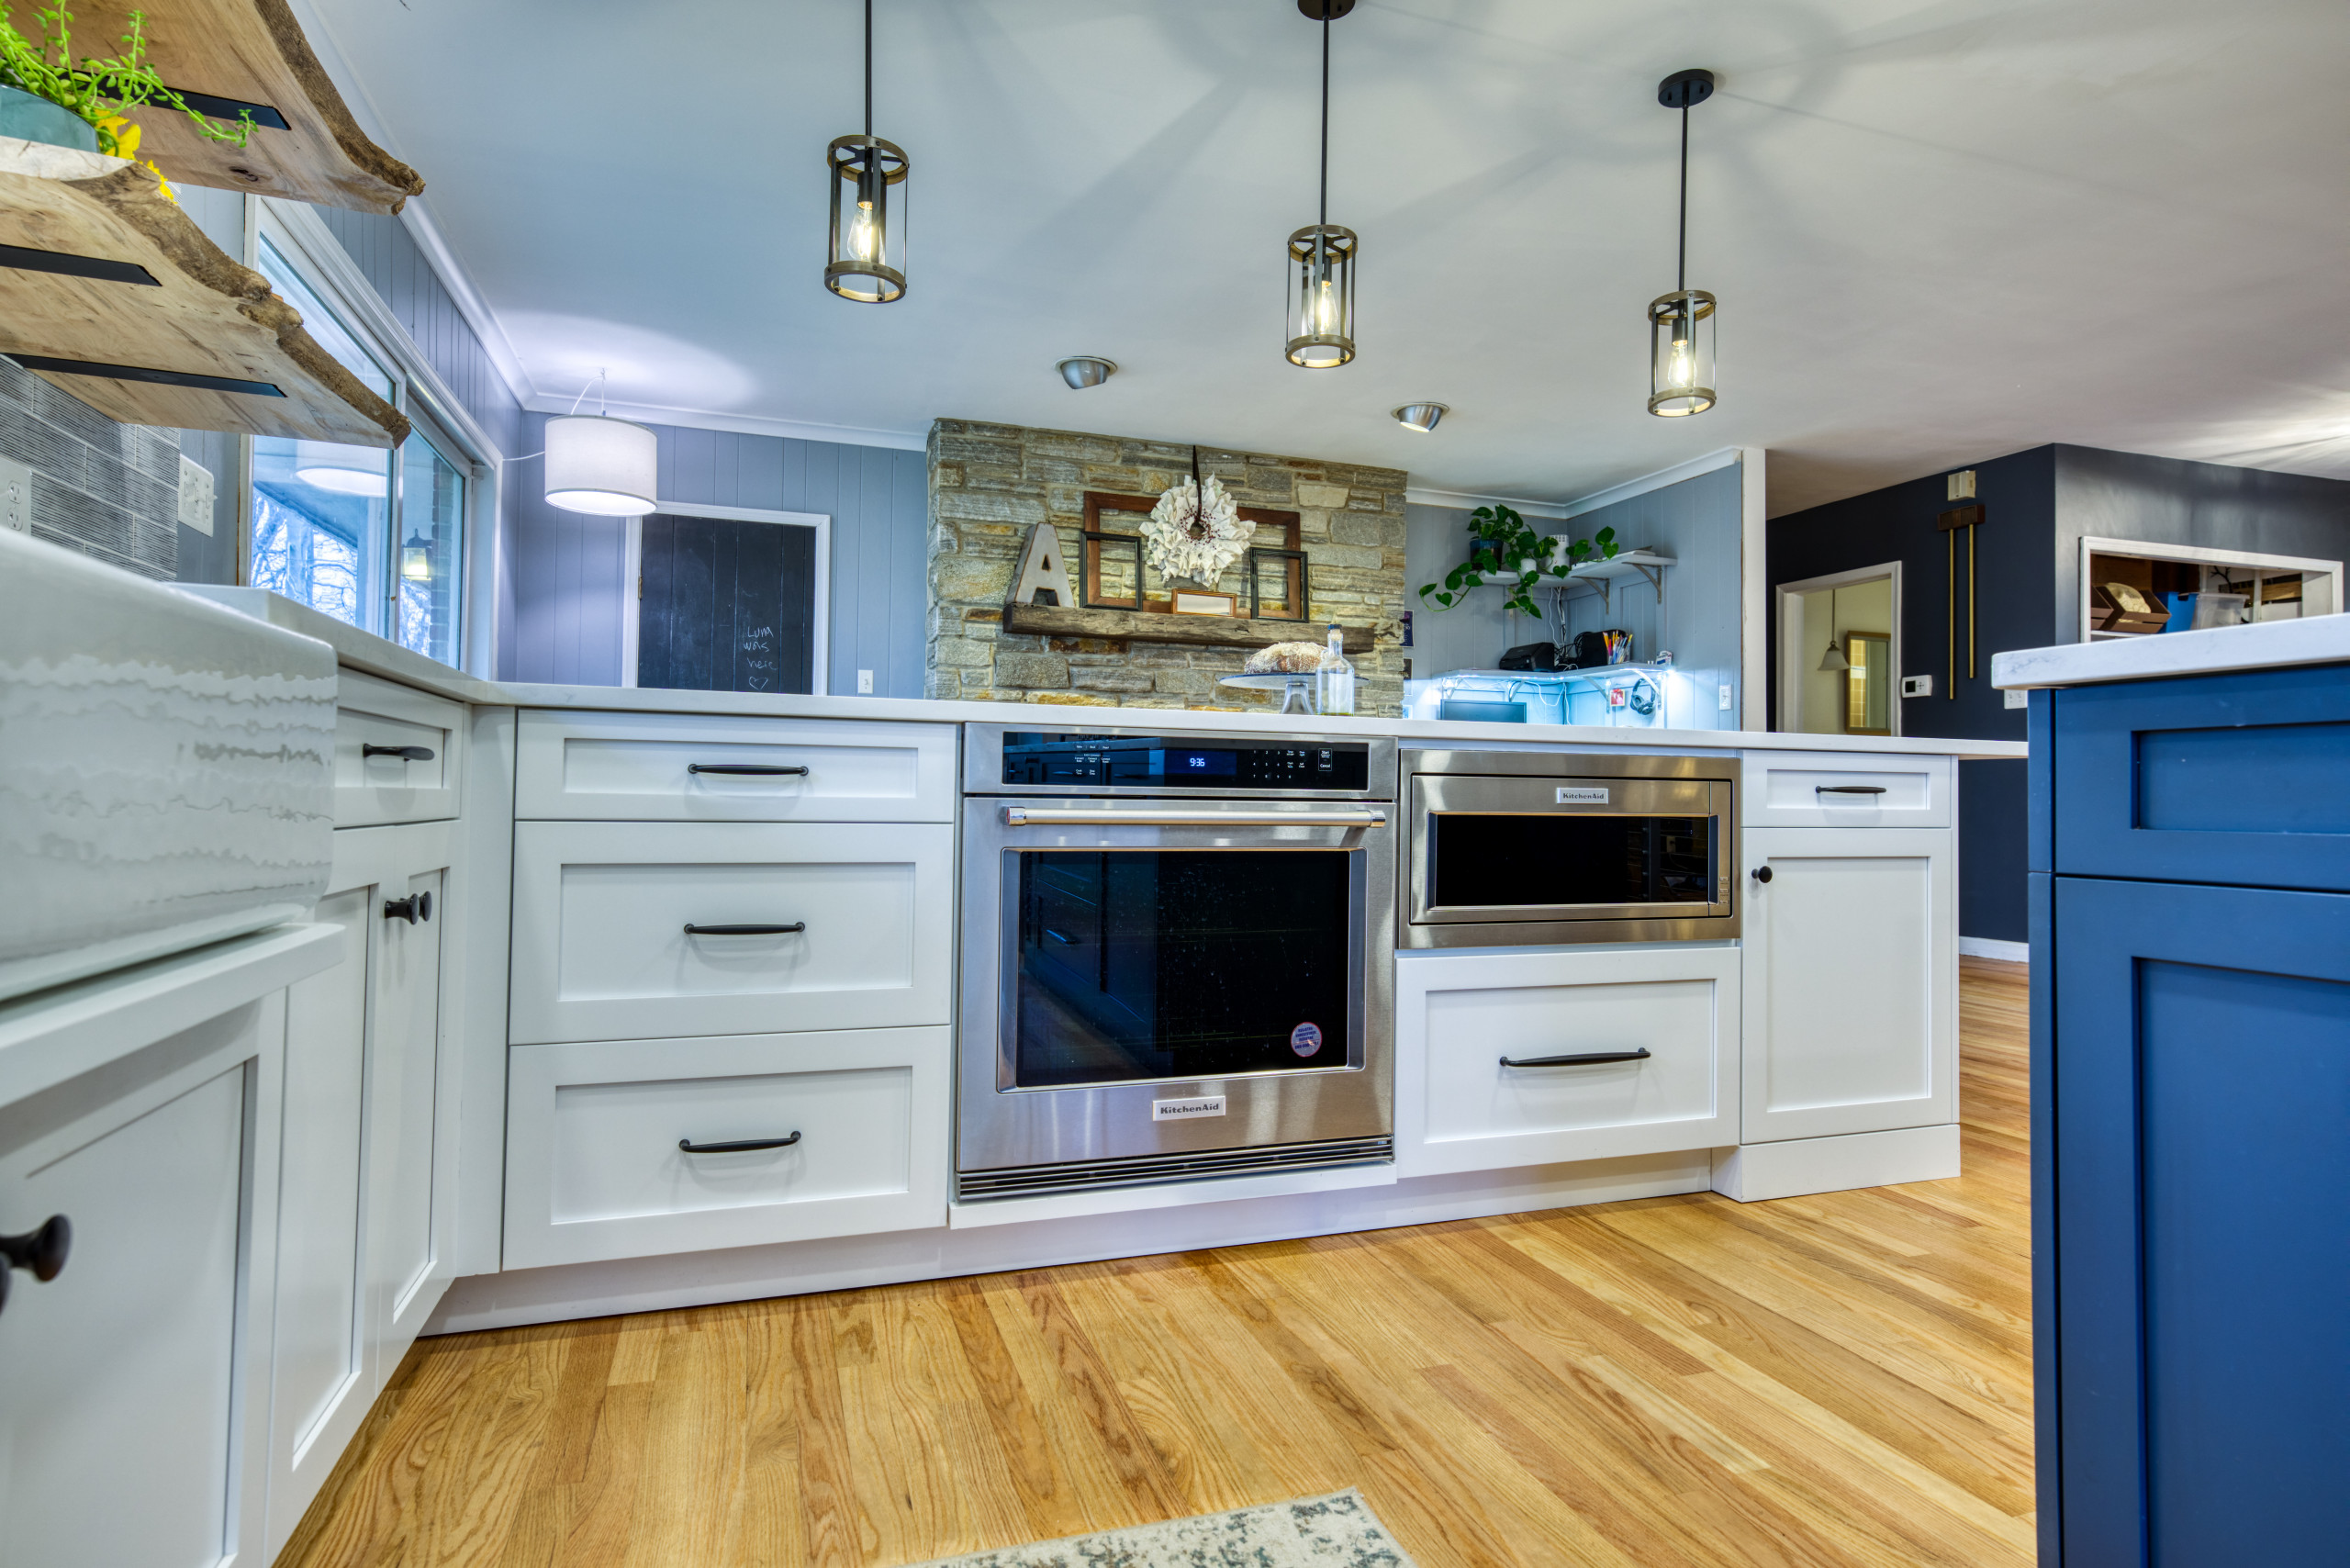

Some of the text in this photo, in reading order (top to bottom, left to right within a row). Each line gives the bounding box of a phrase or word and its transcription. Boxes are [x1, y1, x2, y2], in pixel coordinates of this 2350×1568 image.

[1005, 521, 1075, 608] A
[744, 641, 769, 653] was
[747, 657, 778, 670] here
[1190, 757, 1205, 767] 9:36
[1160, 1103, 1219, 1114] KitchenAid
